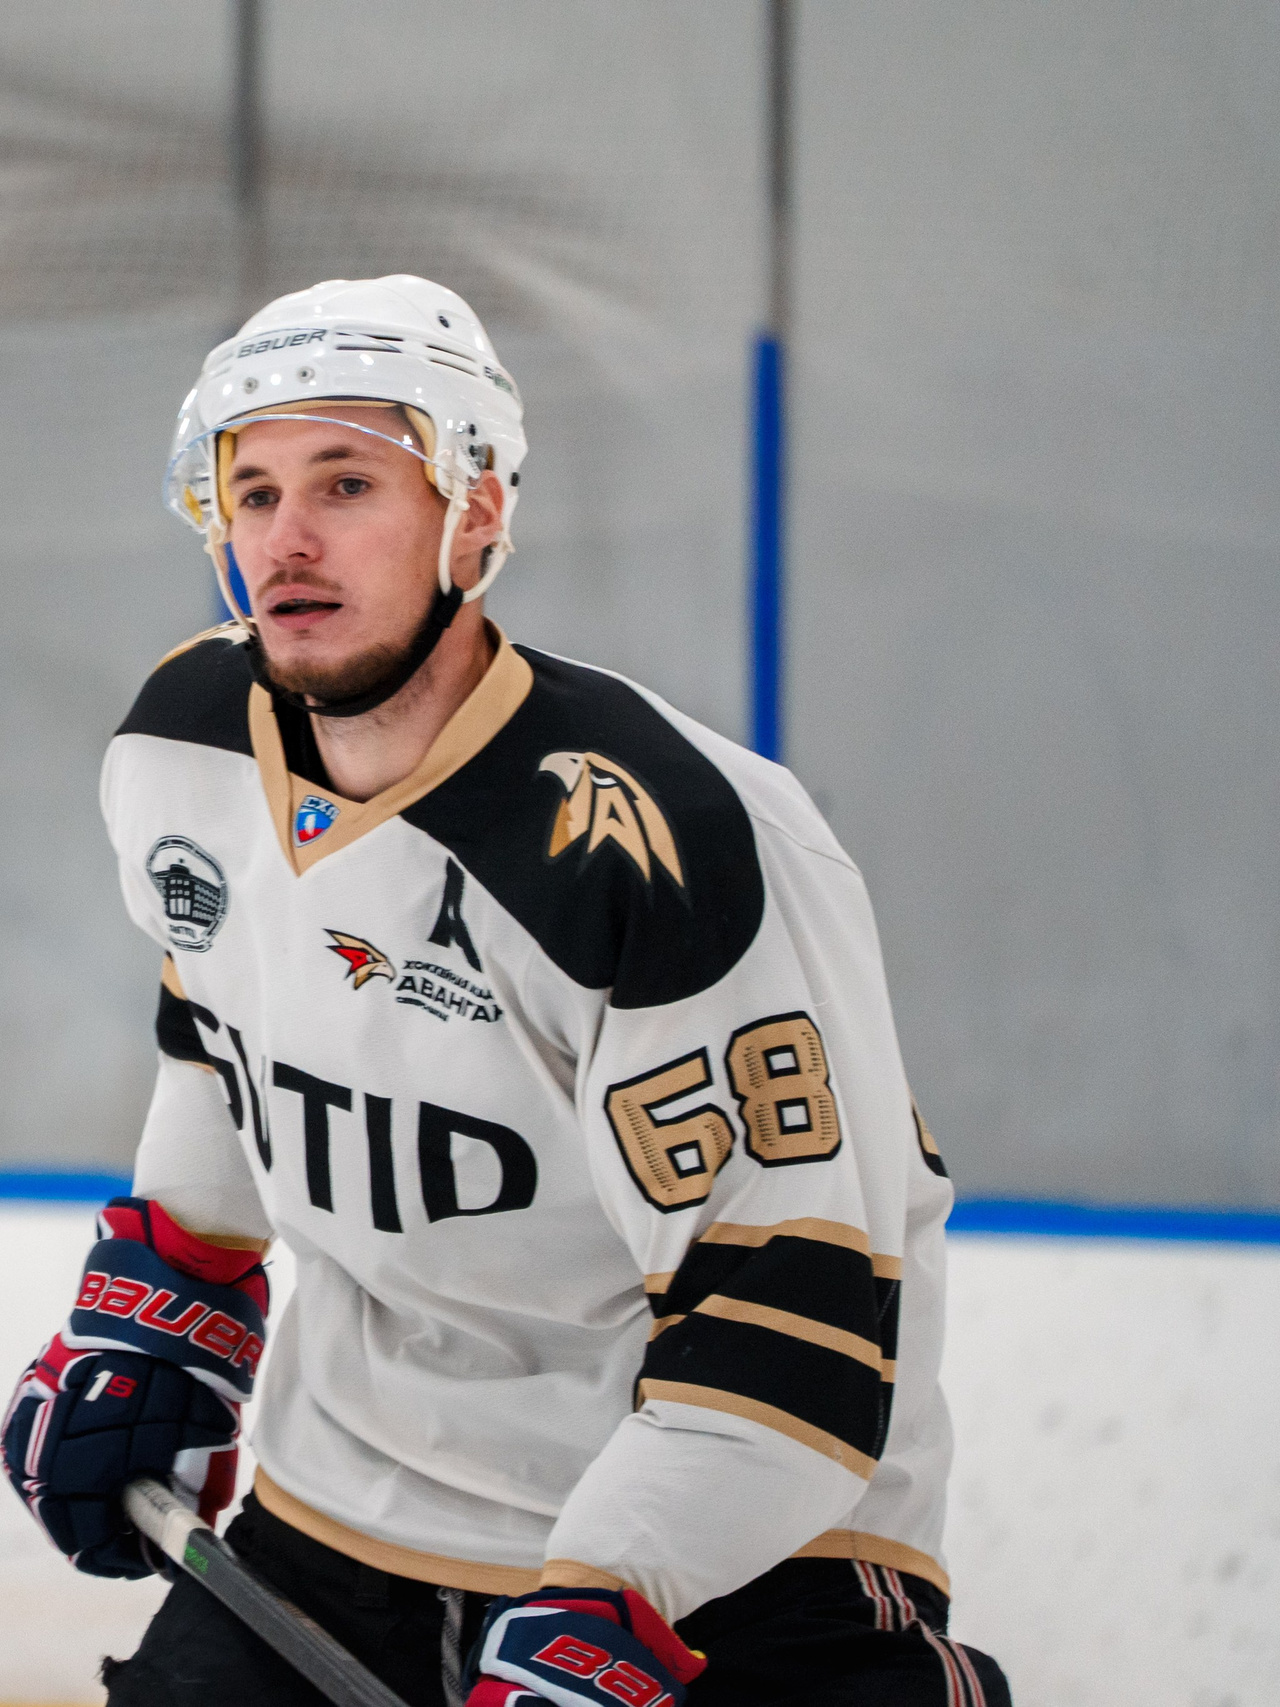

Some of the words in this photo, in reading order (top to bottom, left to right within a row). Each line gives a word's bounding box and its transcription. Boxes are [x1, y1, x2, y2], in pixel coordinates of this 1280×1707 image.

[237, 328, 328, 358] BAUER
[604, 1010, 842, 1214] 68
[75, 1271, 265, 1379] BAUER
